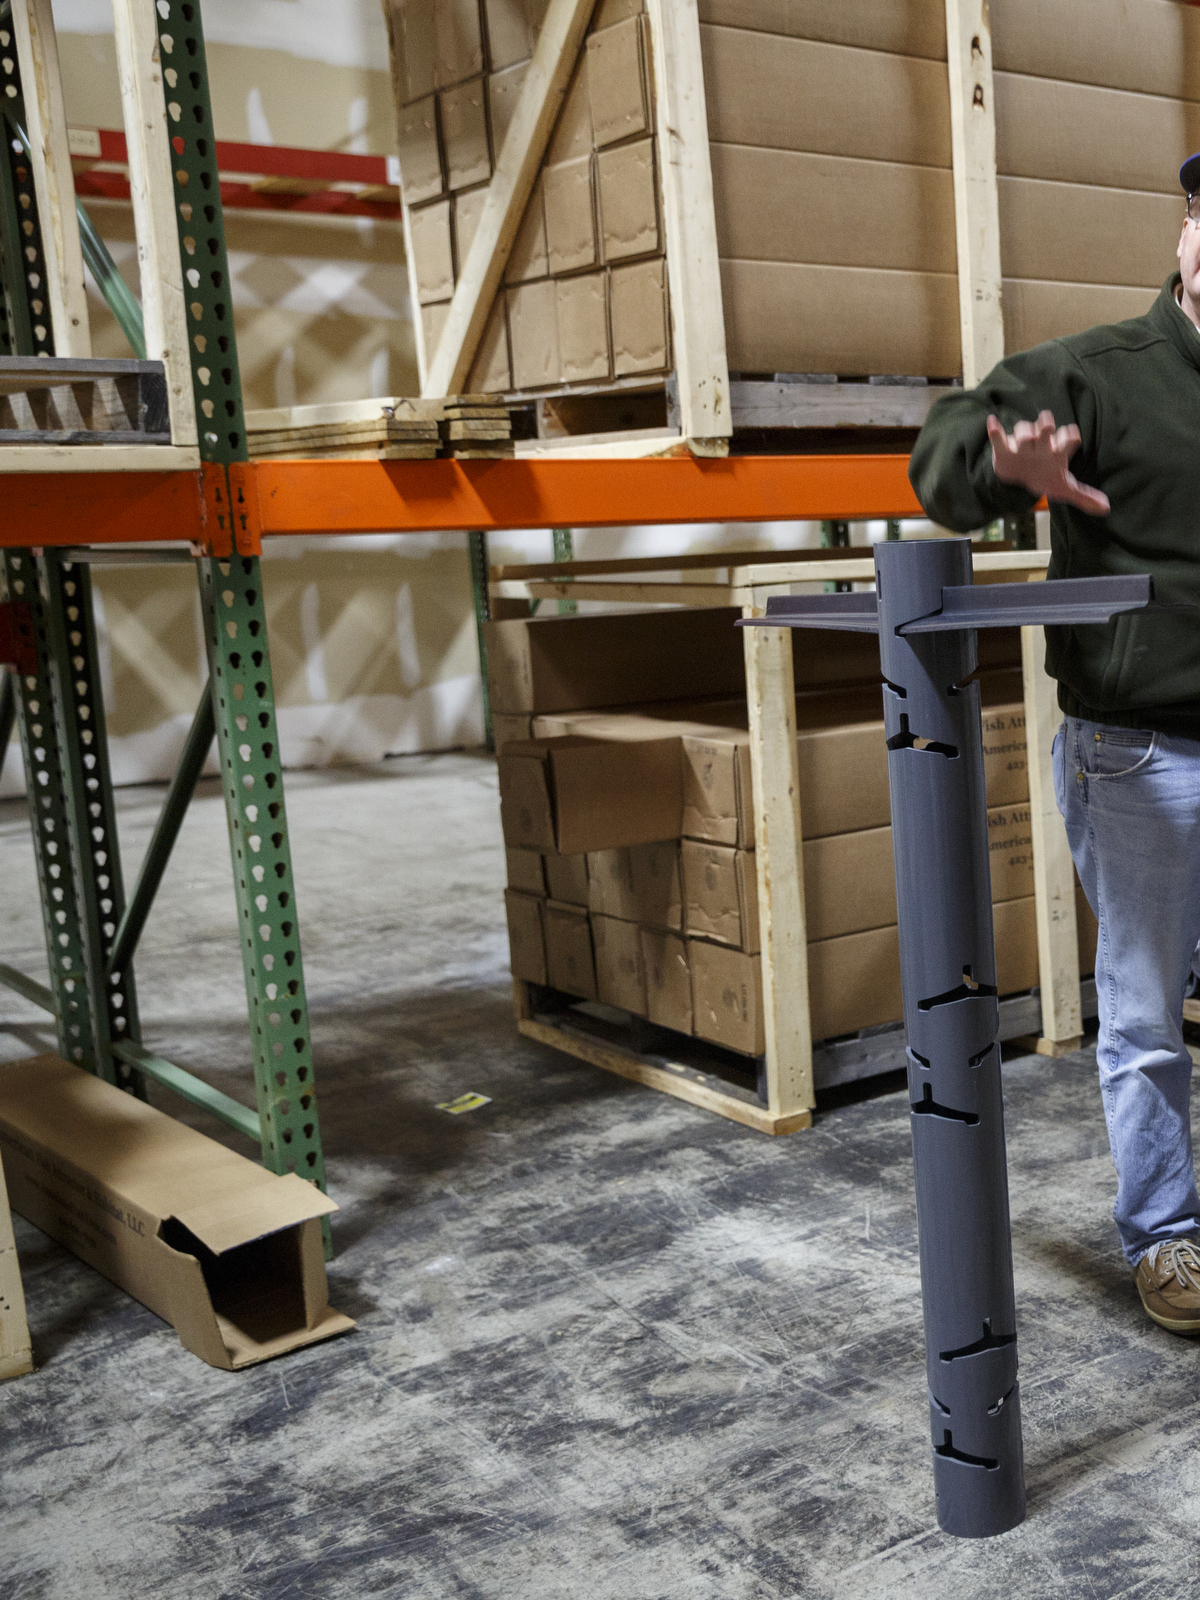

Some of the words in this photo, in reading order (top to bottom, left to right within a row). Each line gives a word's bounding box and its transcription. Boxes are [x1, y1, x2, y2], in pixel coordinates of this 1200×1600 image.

[984, 717, 1005, 732] ish
[1007, 716, 1026, 730] Att
[988, 812, 1007, 827] ish
[1009, 811, 1031, 824] Att
[127, 1212, 145, 1237] LLC
